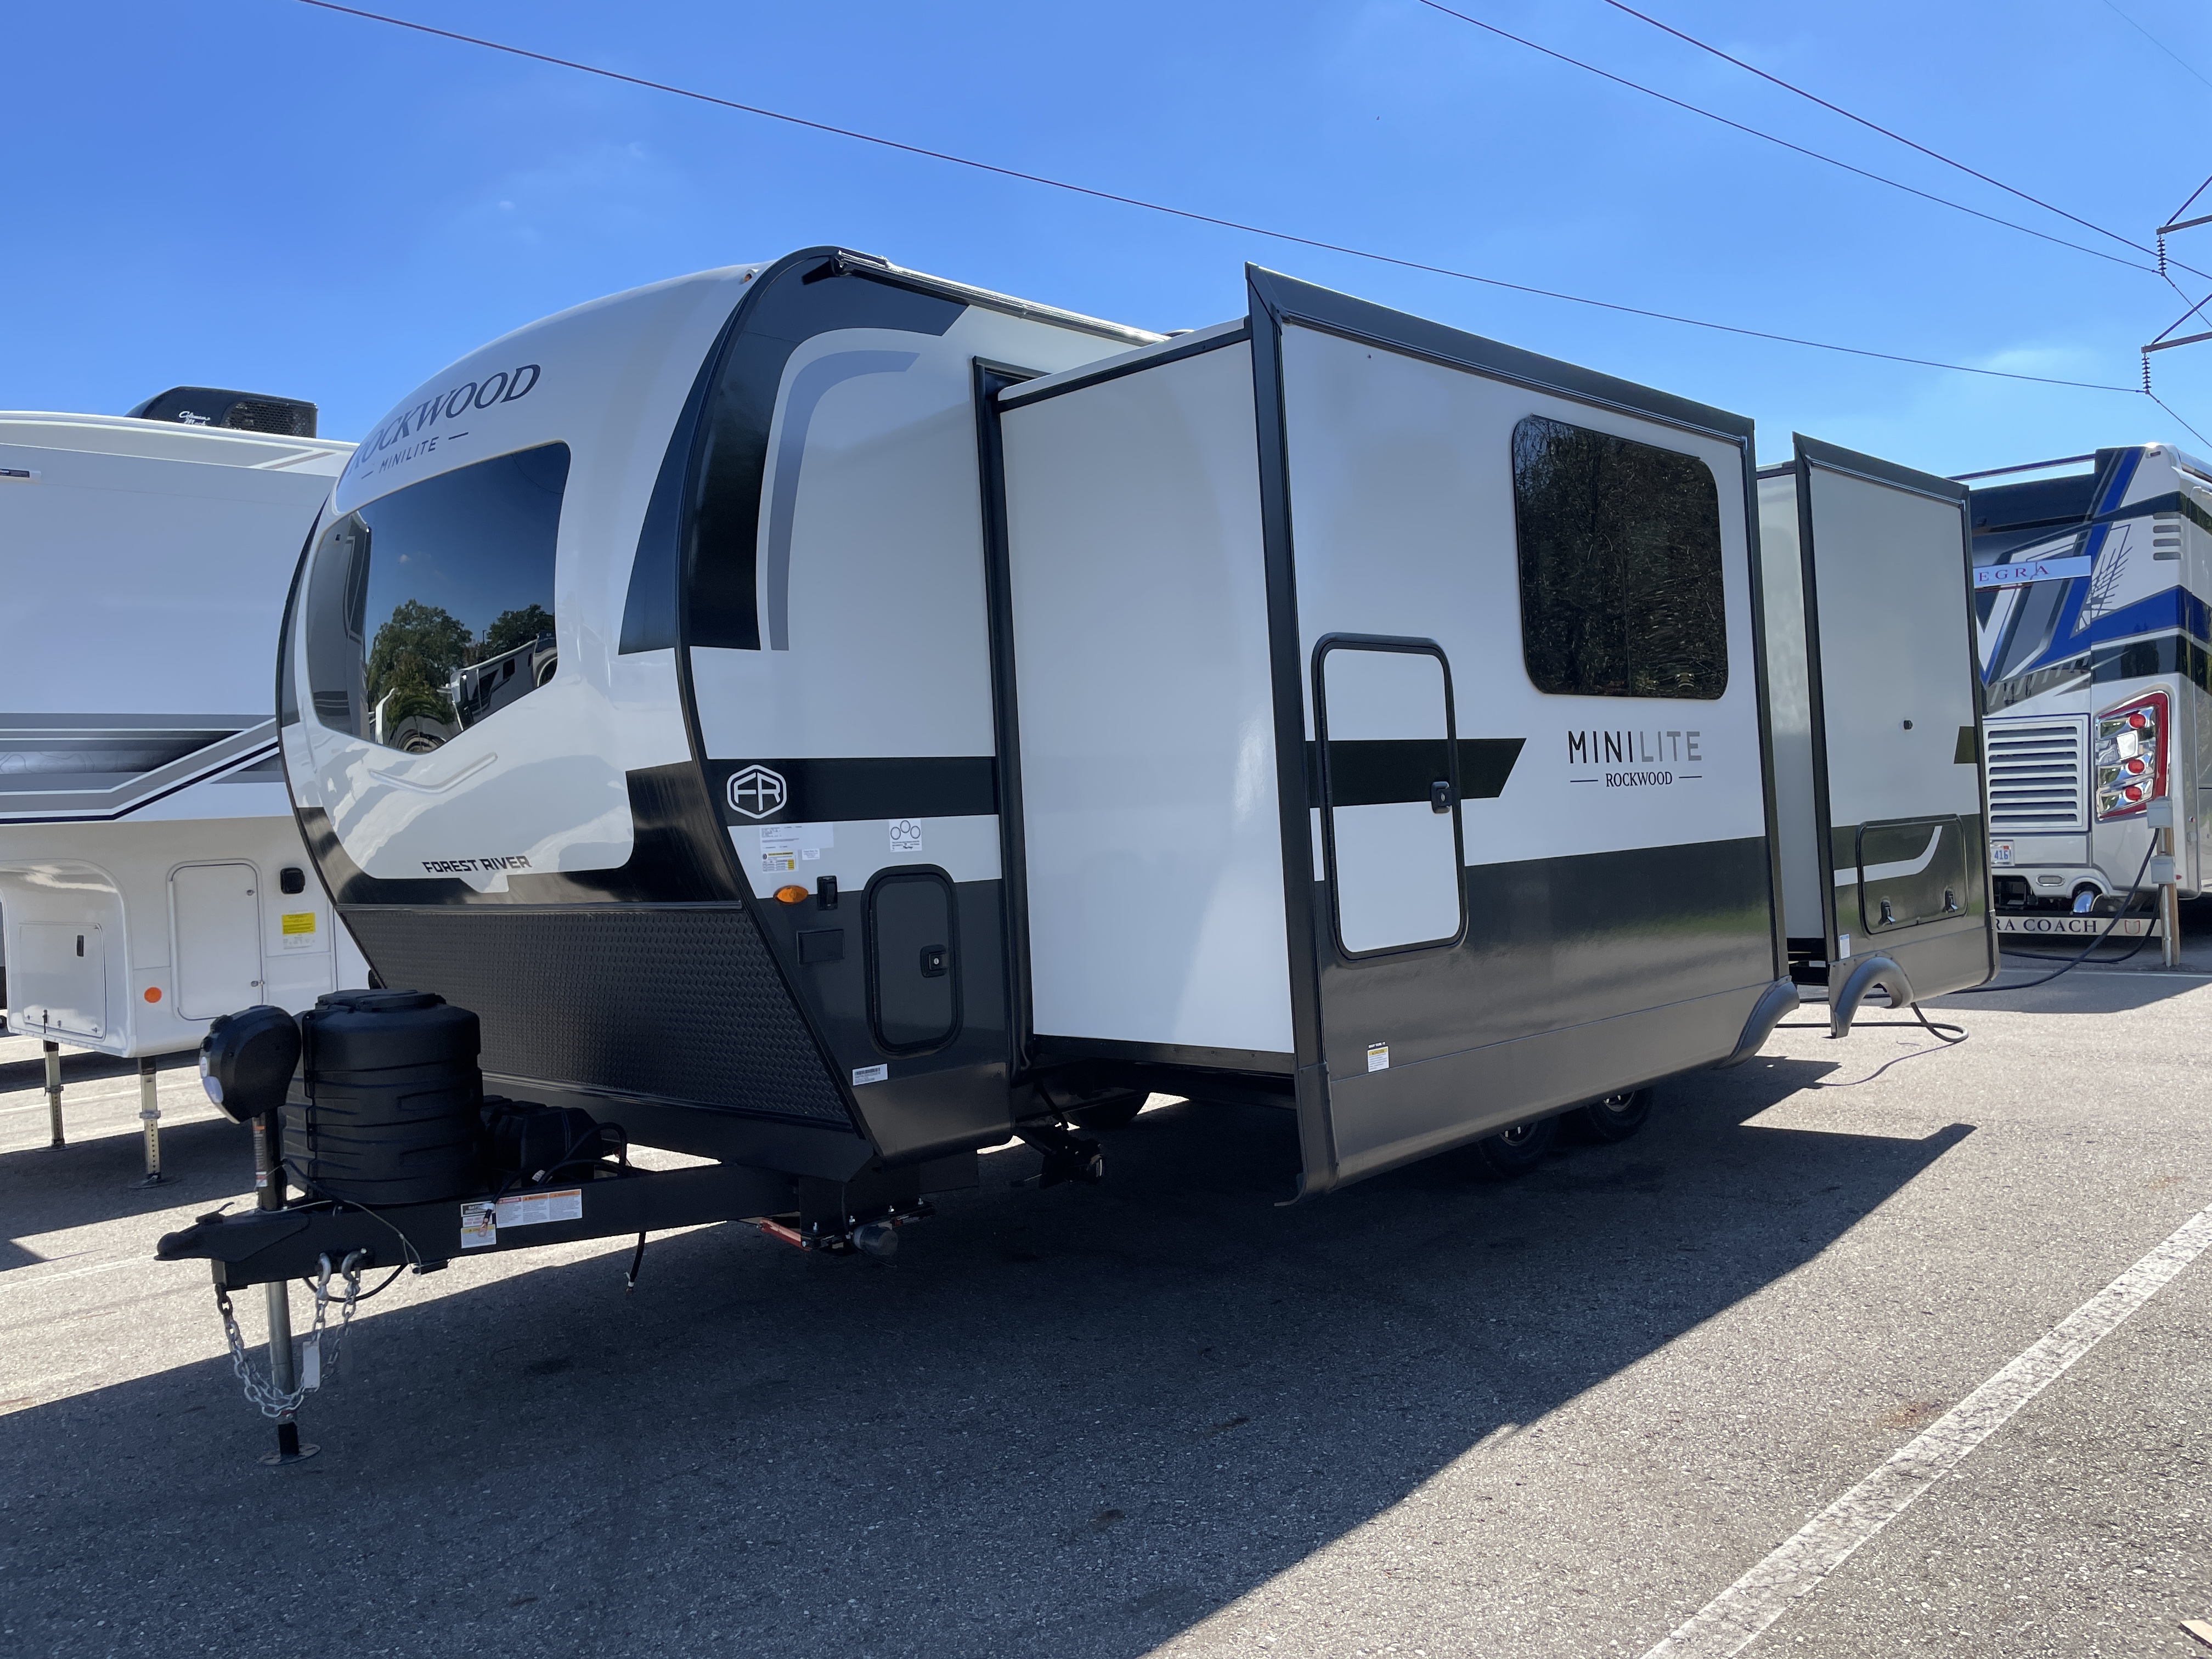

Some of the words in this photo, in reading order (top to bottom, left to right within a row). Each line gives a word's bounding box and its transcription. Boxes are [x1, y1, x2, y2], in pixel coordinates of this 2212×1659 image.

[347, 364, 540, 477] ROCKWOOD
[379, 436, 439, 473] MINILITE
[1568, 731, 1702, 764] MINILITE
[1605, 771, 1673, 787] ROCKWOOD
[421, 860, 479, 873] FOREST
[478, 855, 533, 871] RIVER
[1994, 850, 2008, 860] 416
[2023, 919, 2097, 933] COACH
